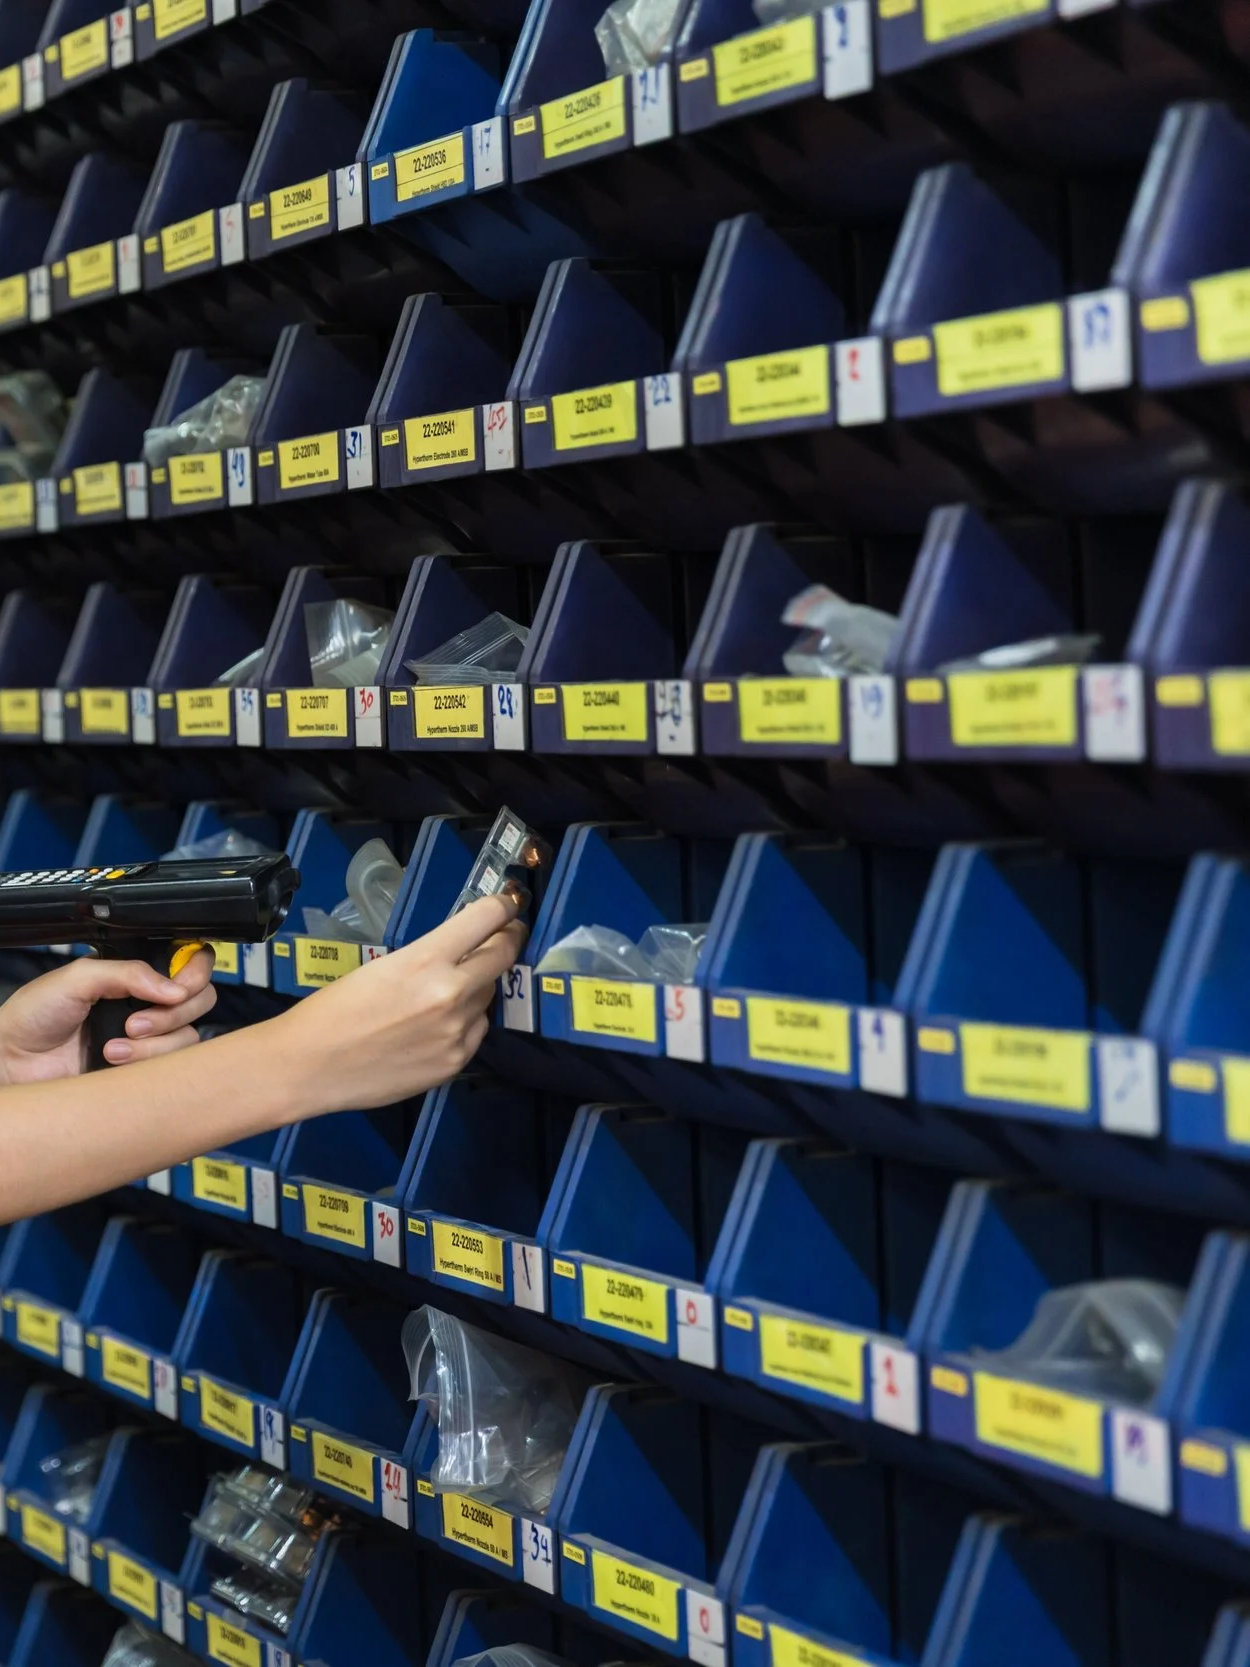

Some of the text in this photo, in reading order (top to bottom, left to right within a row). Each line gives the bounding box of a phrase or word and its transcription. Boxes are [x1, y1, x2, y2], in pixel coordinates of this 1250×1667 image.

[413, 149, 447, 173] 22-220536
[423, 420, 456, 438] 22-220541
[413, 454, 433, 464] Hypertherm
[433, 451, 450, 461] Electrode
[433, 694, 467, 710] 22-220542
[427, 725, 447, 735] Hypertherm
[448, 725, 460, 733] Nozzle
[378, 1211, 394, 1239] 30
[452, 1232, 484, 1254] 22-220553
[439, 1257, 463, 1272] Hypertherm
[464, 1264, 475, 1276] Swirl
[474, 1267, 484, 1280] Ring
[461, 1503, 494, 1528] 22-220554
[452, 1528, 476, 1546] Hypertherm
[616, 1569, 655, 1596] 22-220480
